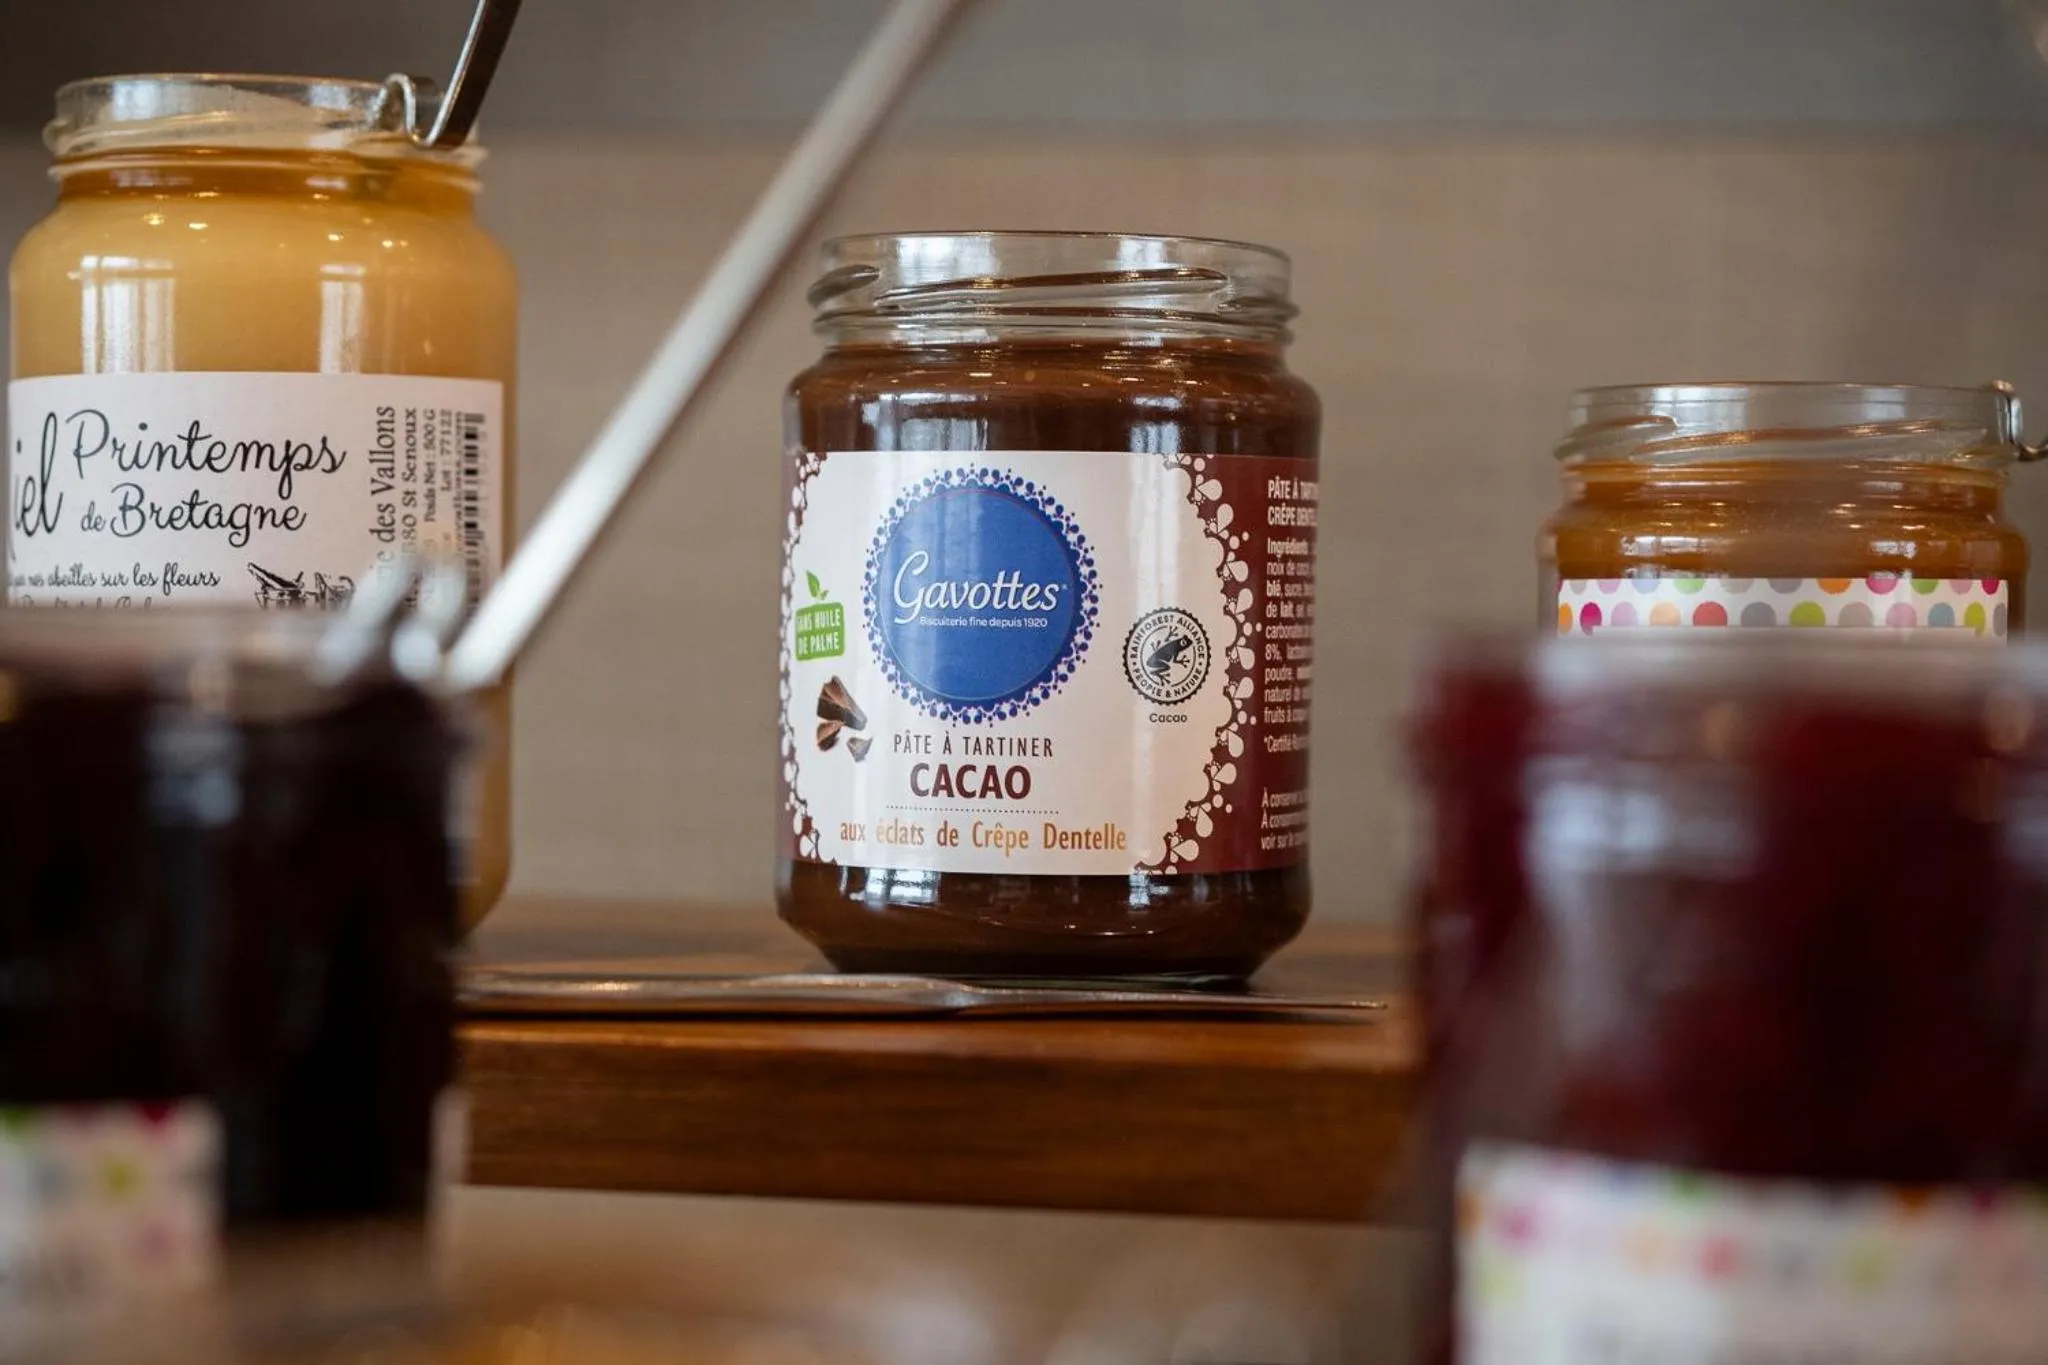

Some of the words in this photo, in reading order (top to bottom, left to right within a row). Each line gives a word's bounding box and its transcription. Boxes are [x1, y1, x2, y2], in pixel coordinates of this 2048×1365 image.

[65, 409, 347, 500] Printemps
[369, 405, 396, 496] Vallons
[9, 411, 63, 558] iel
[1267, 475, 1291, 499] PÂTE
[81, 501, 106, 532] de
[110, 482, 307, 548] Bretagne
[369, 503, 396, 543] des
[101, 572, 129, 587] sur
[133, 562, 159, 587] les
[162, 562, 220, 596] fleurs
[893, 551, 1060, 624] Gavottes
[969, 615, 988, 627] fine
[989, 616, 1022, 629] depuis
[1023, 617, 1048, 628] 1920
[1148, 712, 1188, 723] Cacao
[893, 730, 932, 755] PÂTE
[943, 731, 953, 755] À
[963, 736, 1054, 758] TARTINER
[909, 761, 1032, 800] CACAO
[840, 822, 866, 843] aux
[876, 817, 925, 845] éclats
[937, 820, 960, 847] de
[972, 820, 1029, 858] Crêpe
[1043, 822, 1127, 851] Dentelle
